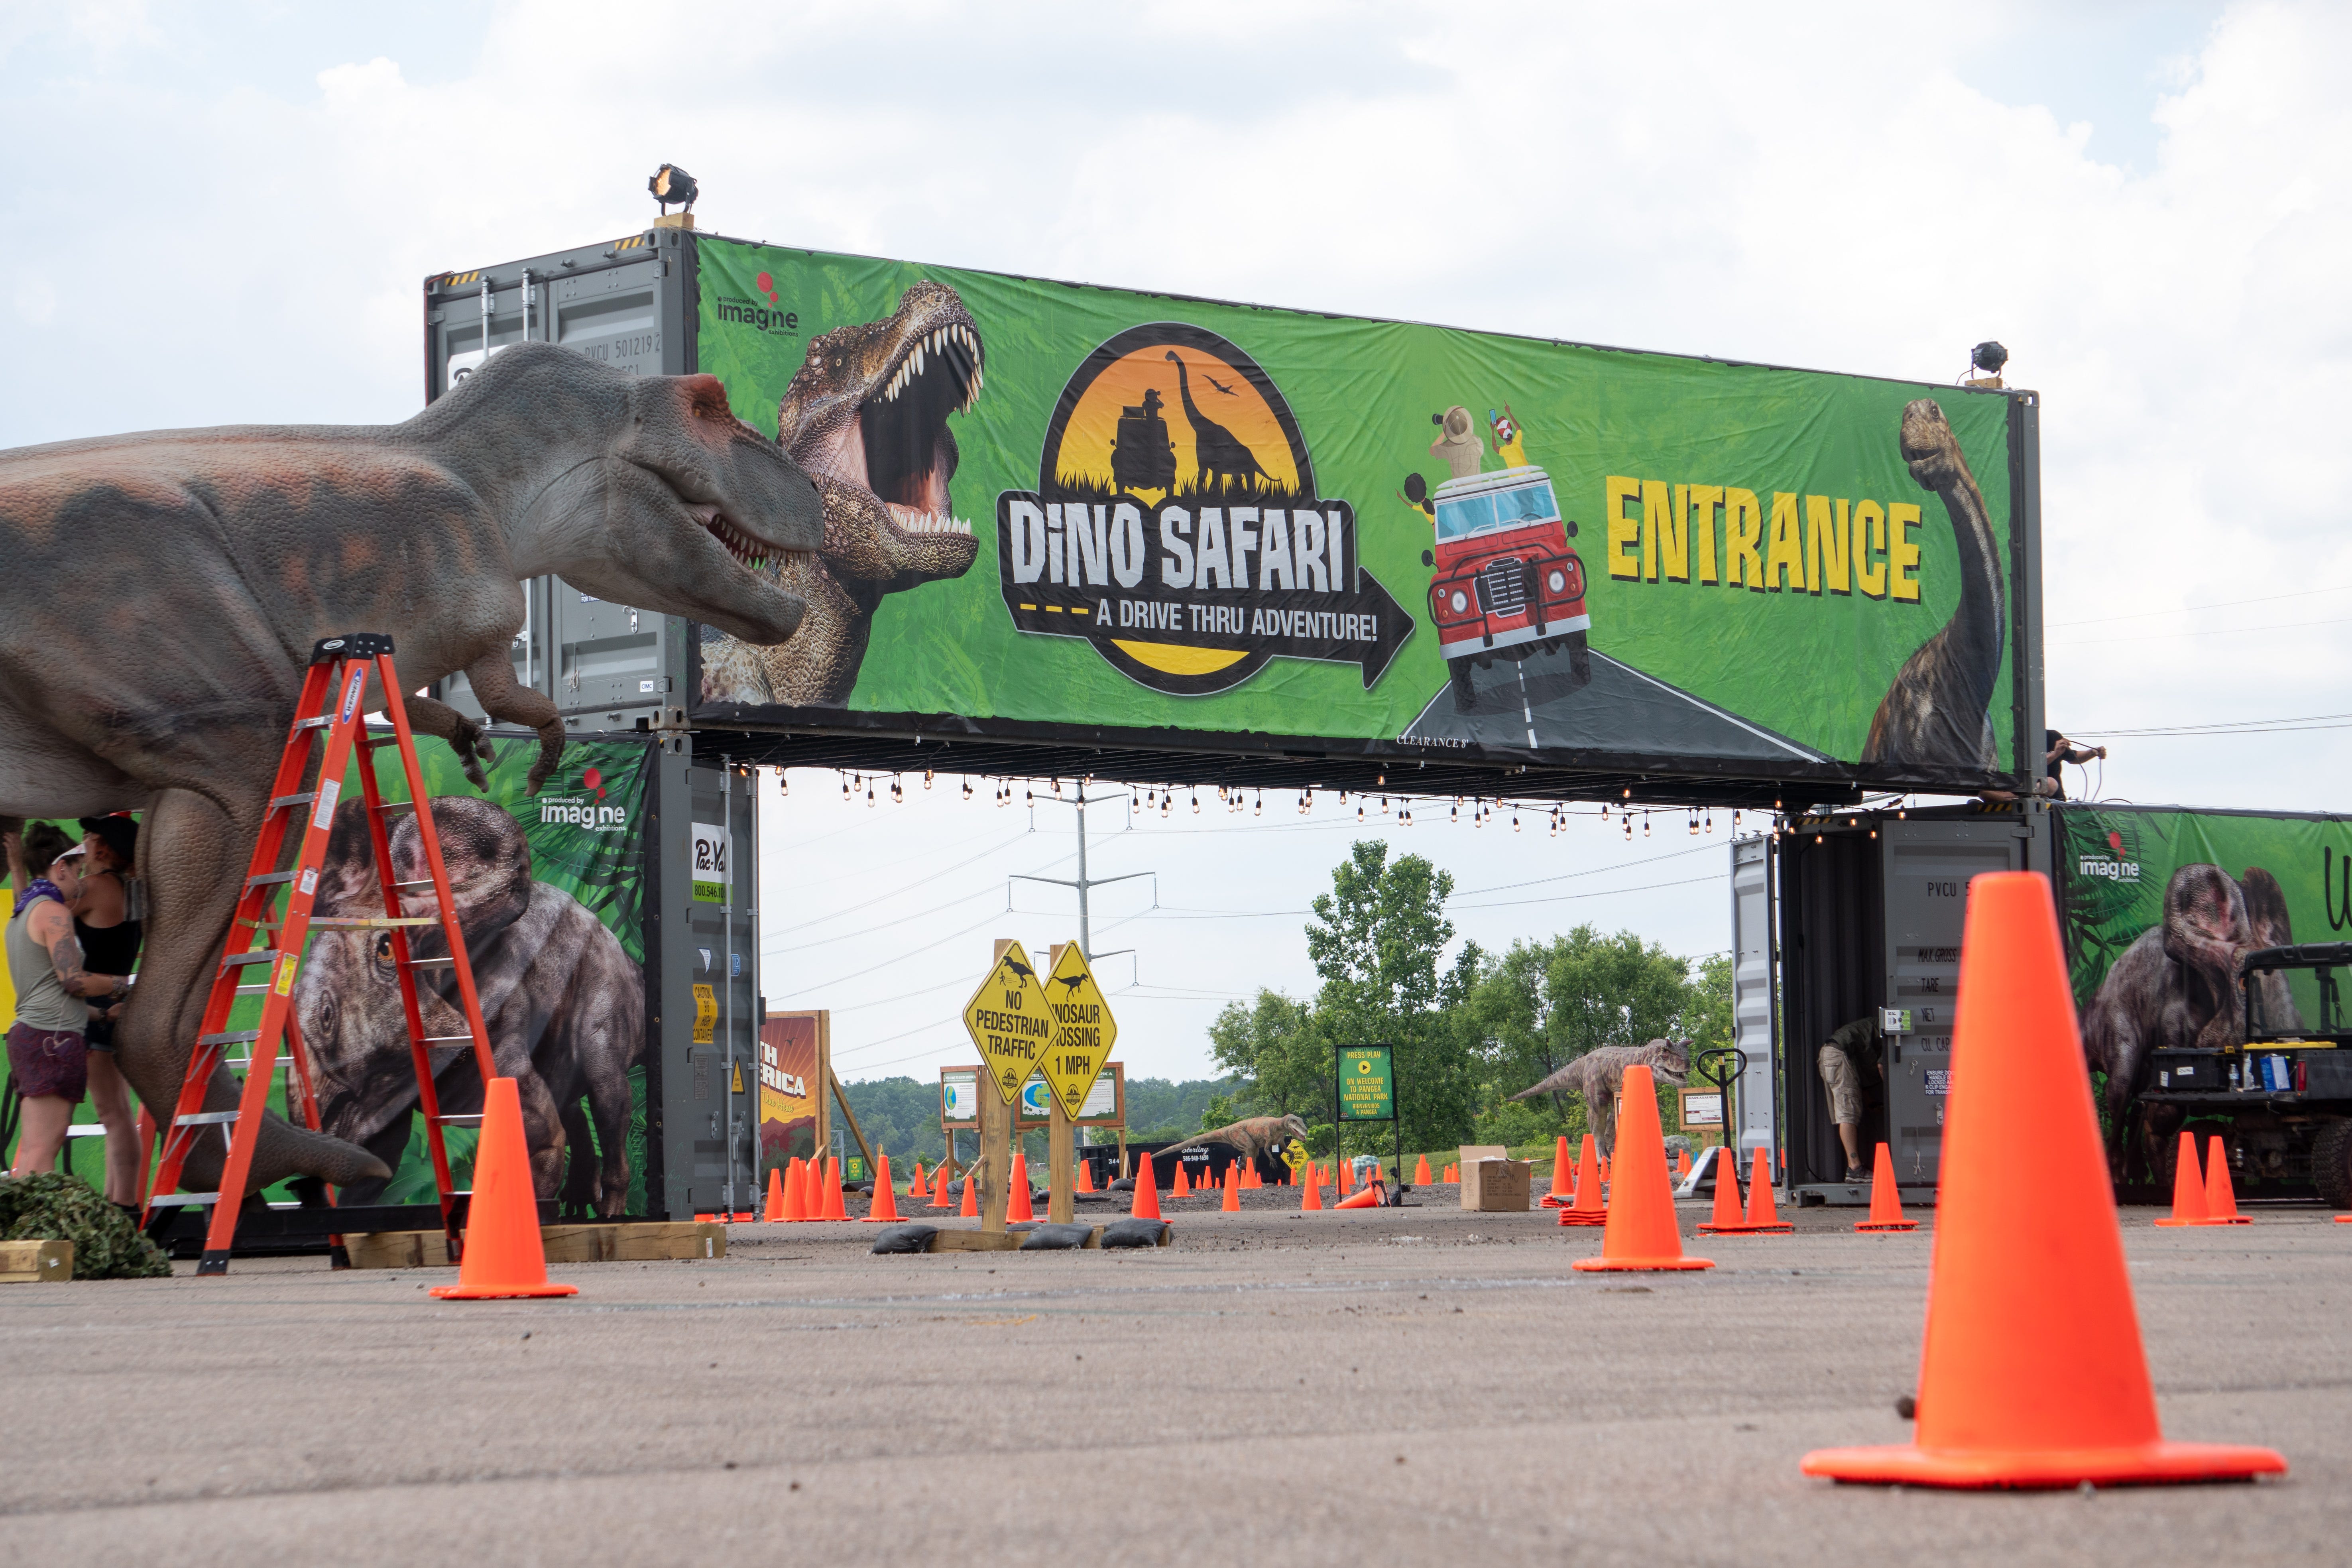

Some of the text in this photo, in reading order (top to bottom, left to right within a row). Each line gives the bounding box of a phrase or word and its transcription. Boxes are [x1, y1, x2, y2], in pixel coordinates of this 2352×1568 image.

[768, 329, 798, 337] exhibitions
[616, 335, 652, 358] 501219
[1160, 505, 1343, 593] SAFARI
[1606, 476, 1922, 605] ENTRANCE
[1096, 598, 1378, 642] A DRIVE THRU ADVENTURE!
[1396, 735, 1459, 748] CLEARANCE
[696, 838, 725, 873] Pac-Va
[1928, 882, 1957, 897] PVCU
[695, 986, 713, 999] CAUTION
[1921, 978, 1939, 992] TARE
[1006, 990, 1022, 1010] NO
[1052, 1003, 1100, 1024] NOSAUR
[1921, 1008, 1935, 1022] NET
[976, 1009, 1049, 1038] PEDESTRIAN
[693, 1028, 713, 1041] CONTAINER
[1052, 1027, 1100, 1047] OSSING
[987, 1035, 1036, 1060] TRAFFIC
[1921, 1037, 1933, 1052] CU.
[1055, 1056, 1090, 1075] 1 MPH
[777, 1098, 794, 1113] Home
